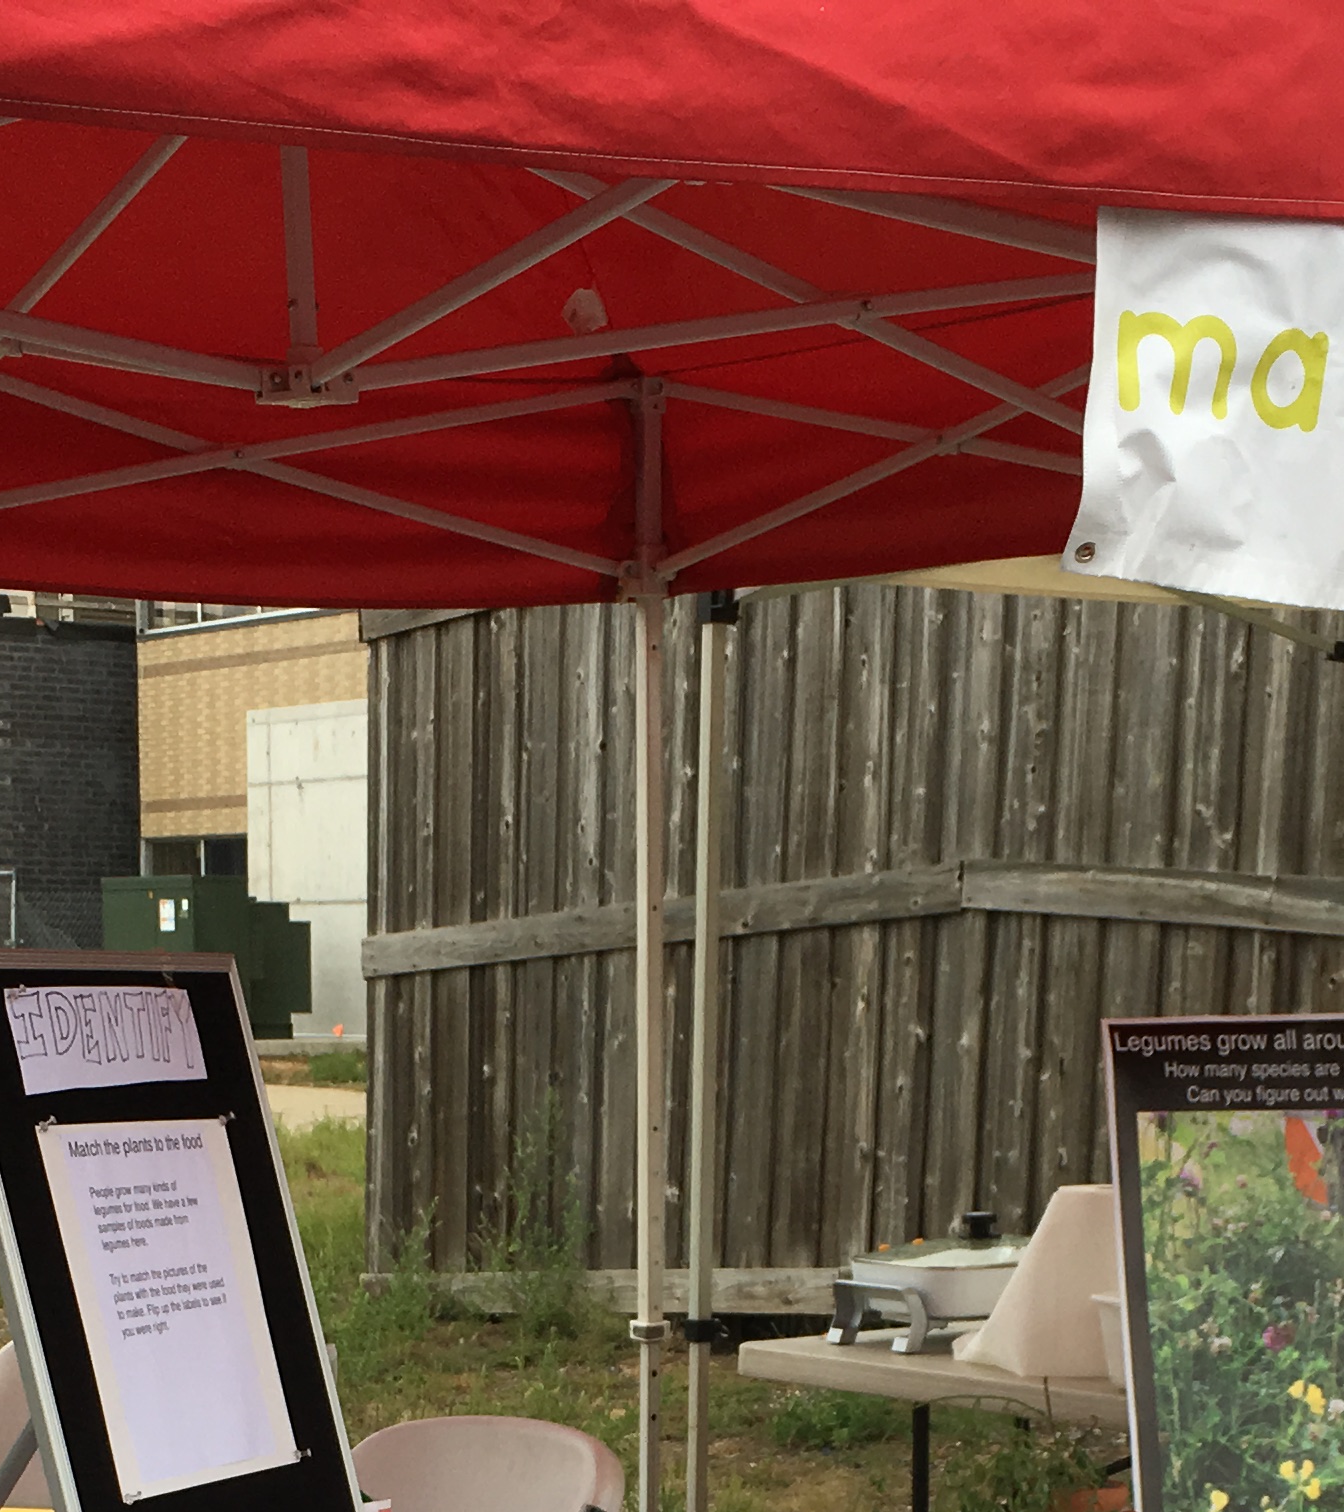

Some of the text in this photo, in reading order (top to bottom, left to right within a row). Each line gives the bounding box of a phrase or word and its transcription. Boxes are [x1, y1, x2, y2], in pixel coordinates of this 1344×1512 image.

[8, 990, 194, 1069] IDENTIFY
[1114, 1031, 1211, 1056] Legumes
[1216, 1034, 1267, 1056] grow
[1274, 1030, 1297, 1050] all
[1165, 1061, 1200, 1078] How
[1204, 1062, 1246, 1080] many
[1251, 1060, 1310, 1079] species
[1315, 1062, 1339, 1076] are
[1187, 1086, 1221, 1103] Can
[1224, 1089, 1252, 1105] you
[1256, 1086, 1300, 1103] figure
[1304, 1087, 1329, 1101] out
[68, 1133, 203, 1157] Match the plants to the food
